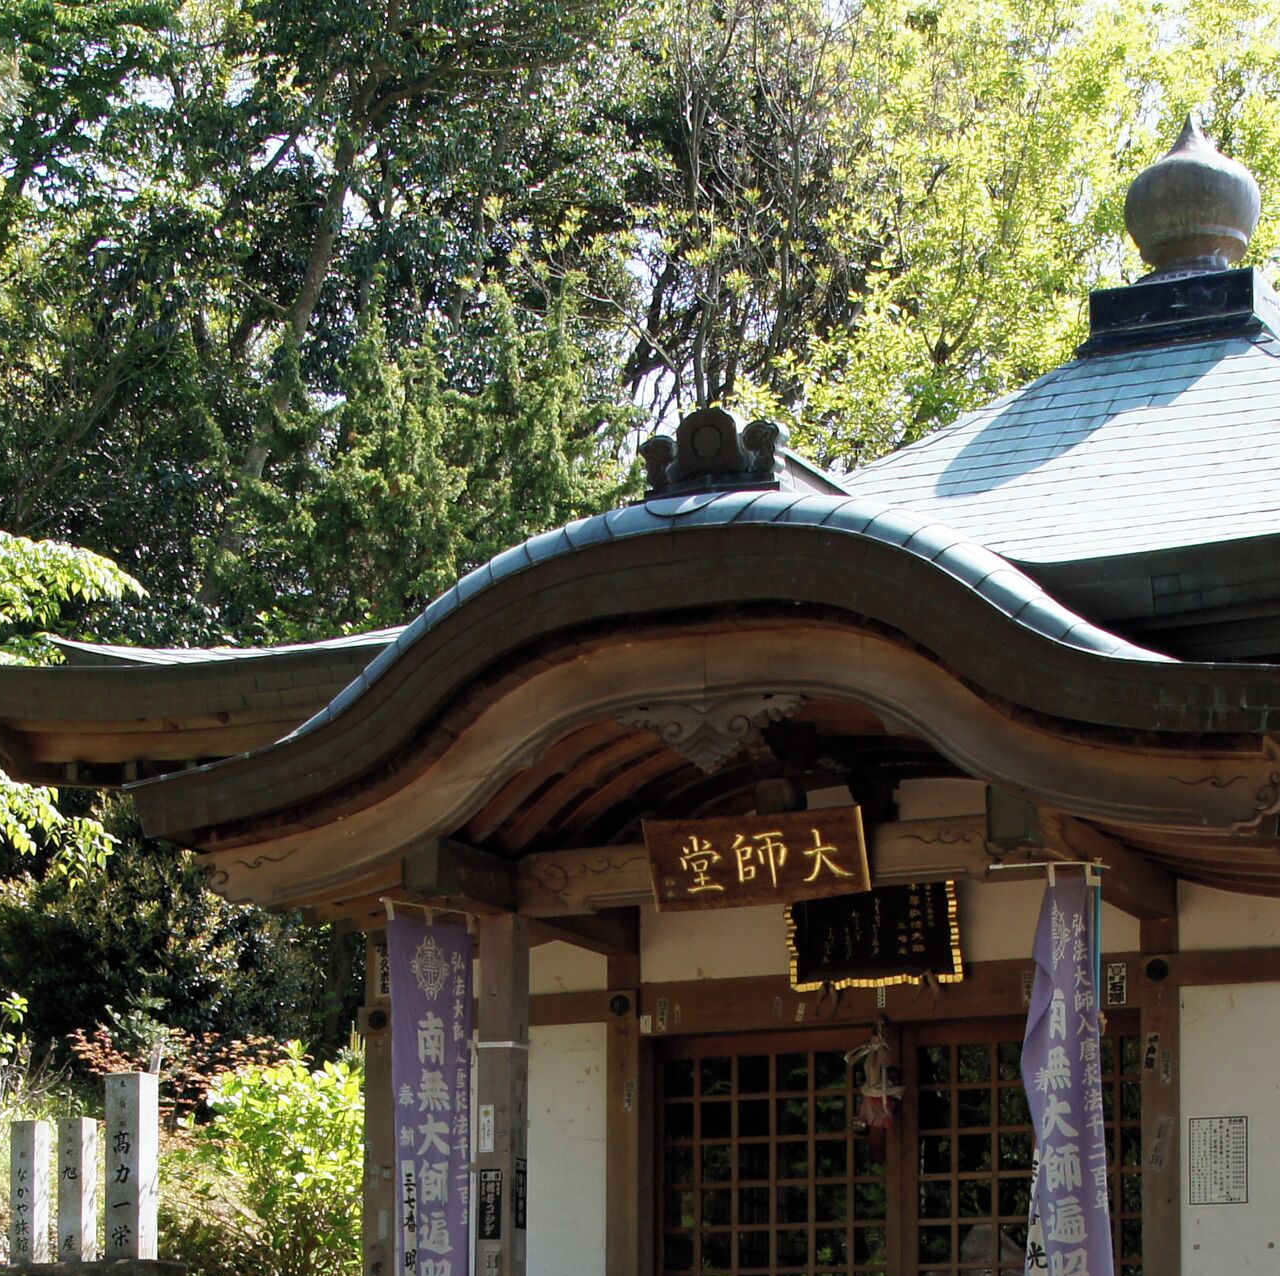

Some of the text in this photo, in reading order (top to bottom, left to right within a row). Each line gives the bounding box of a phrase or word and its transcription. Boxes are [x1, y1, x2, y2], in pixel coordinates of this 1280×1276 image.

[678, 828, 853, 893] 大師堂
[15, 1167, 30, 1254] なかや旅館
